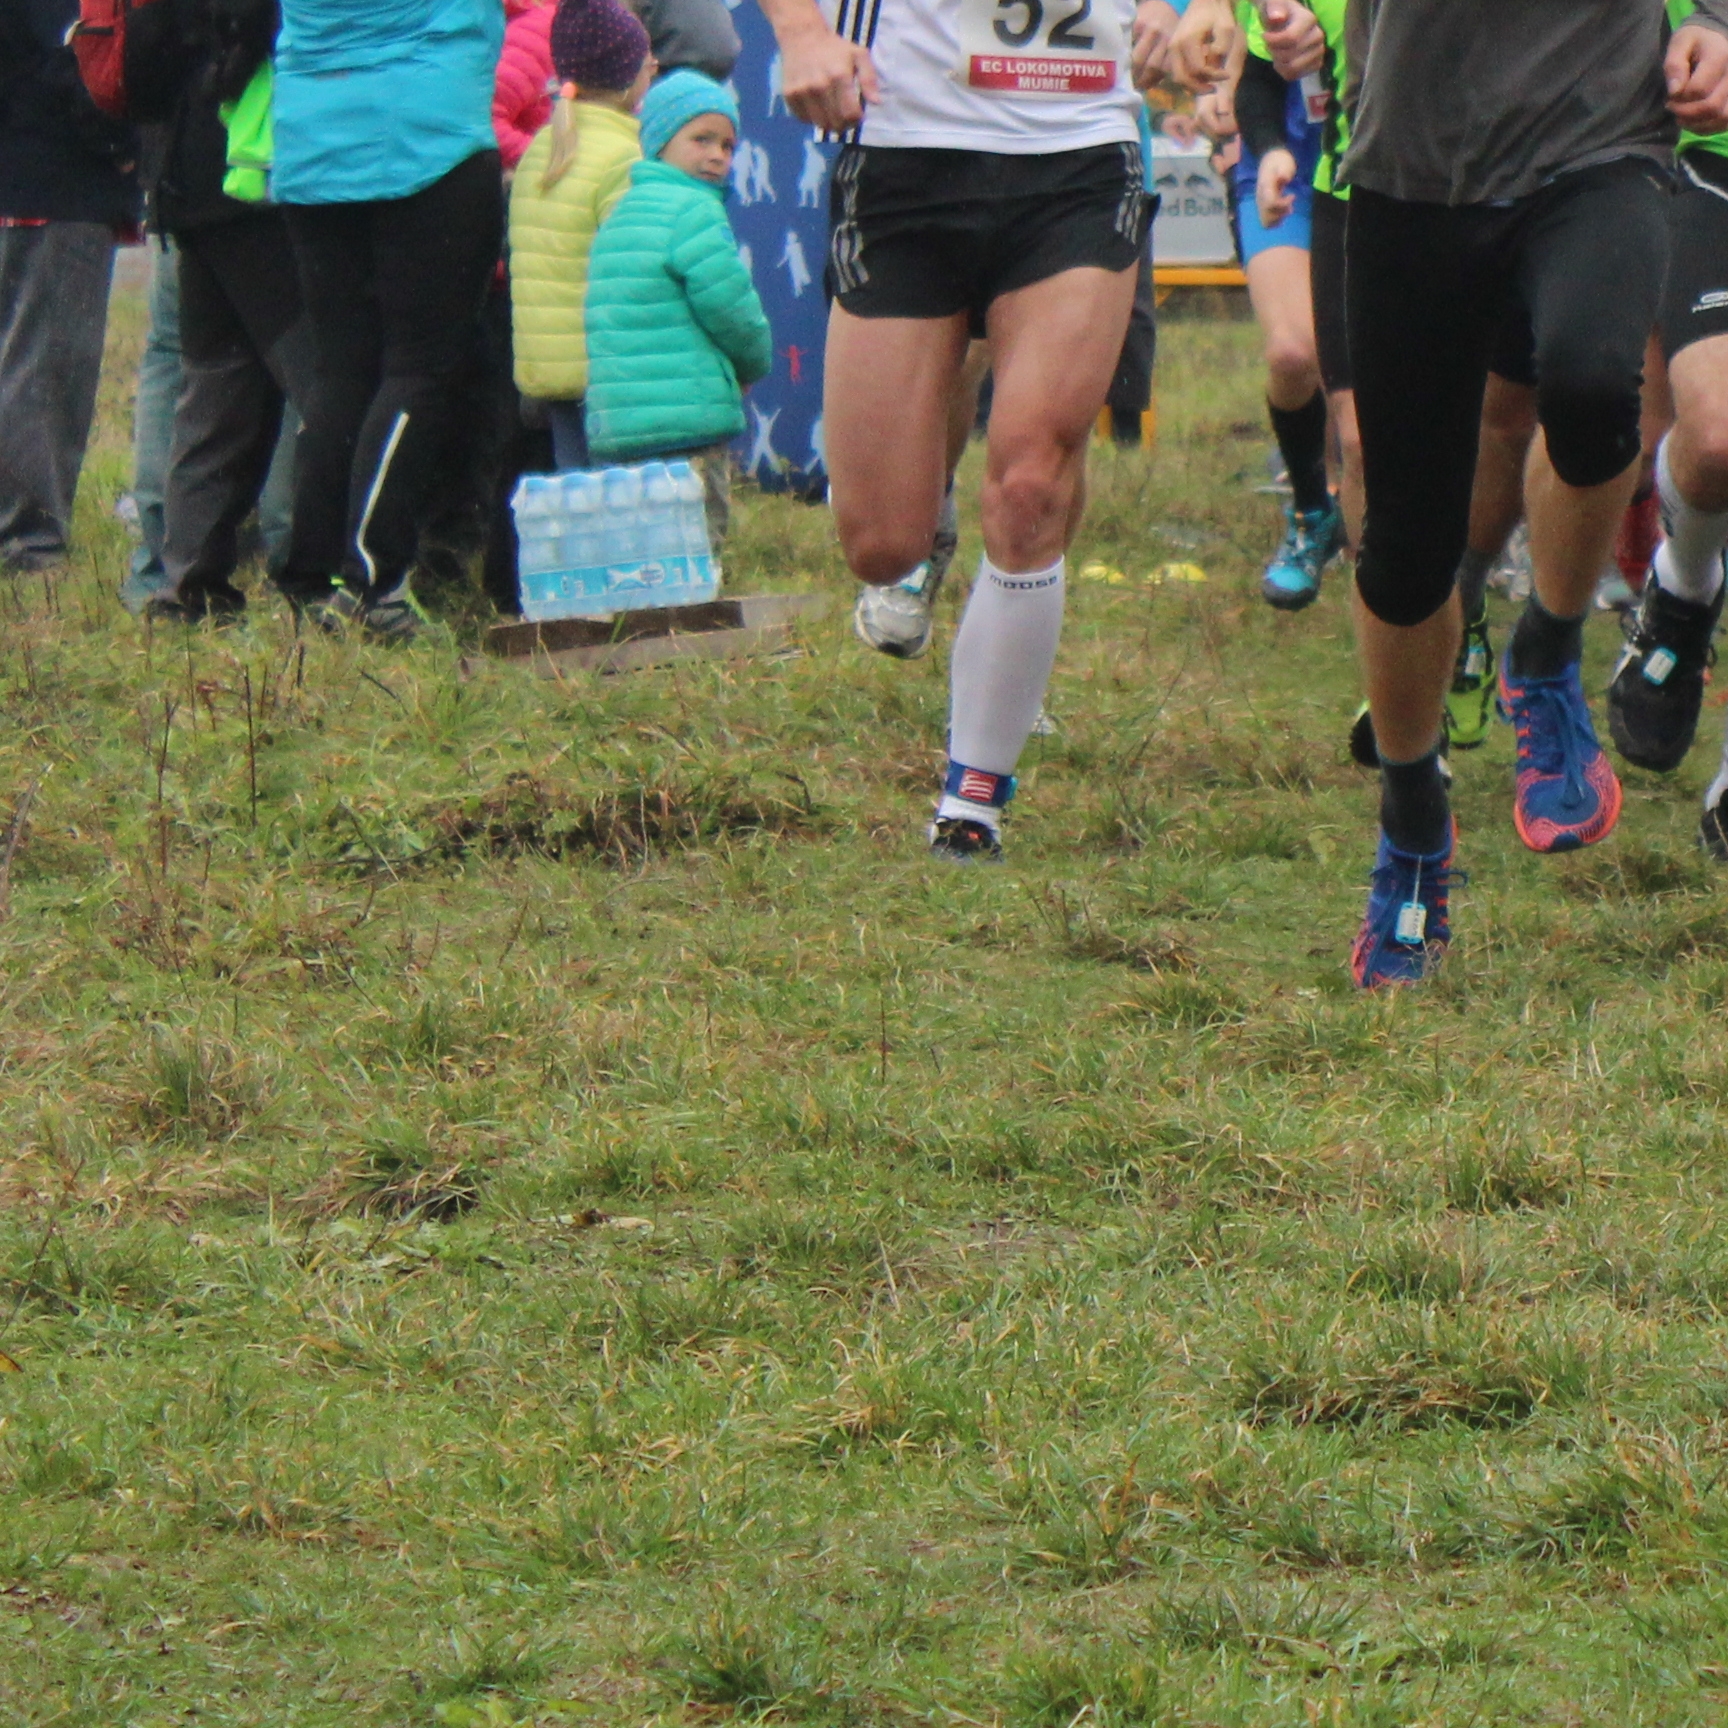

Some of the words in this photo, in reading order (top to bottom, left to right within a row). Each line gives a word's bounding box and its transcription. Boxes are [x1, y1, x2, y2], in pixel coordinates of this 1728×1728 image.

[980, 59, 1003, 73] EC
[1006, 60, 1107, 78] LOKOMOTIVA
[1018, 76, 1070, 91] MUMIE
